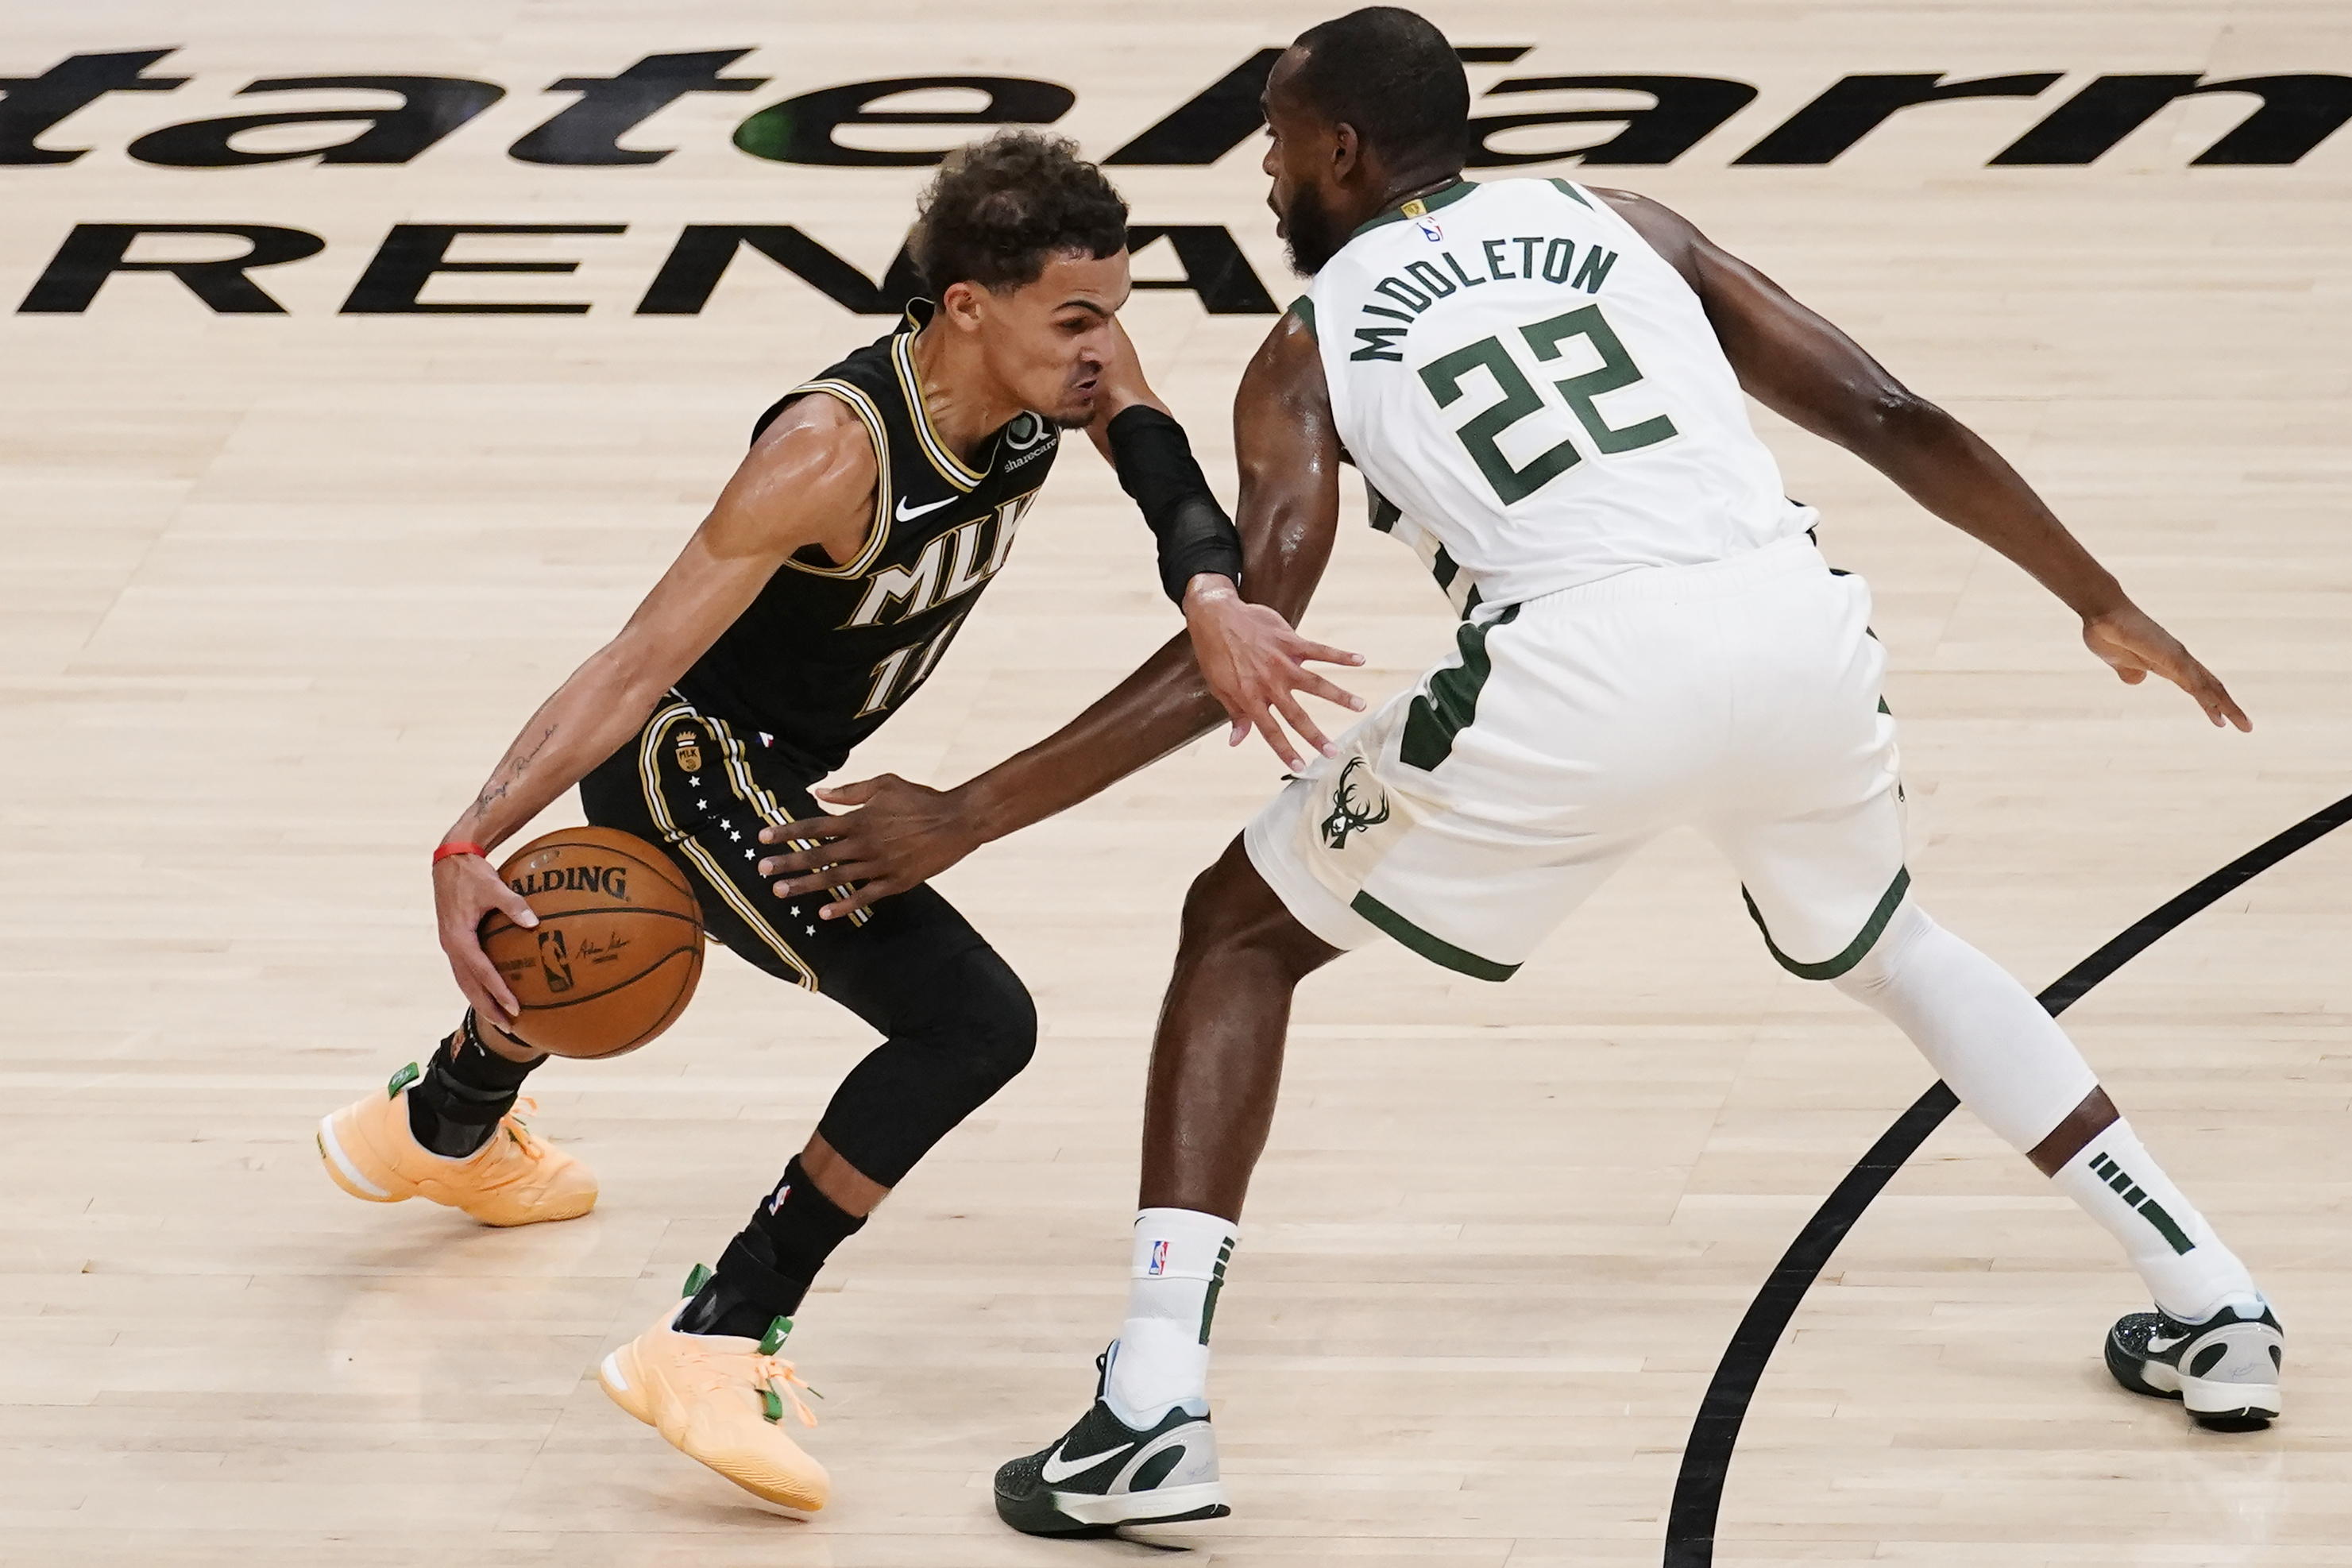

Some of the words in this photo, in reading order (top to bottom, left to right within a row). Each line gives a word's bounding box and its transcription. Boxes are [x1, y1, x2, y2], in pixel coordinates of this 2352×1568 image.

[1350, 236, 1619, 364] MIDDLETON
[1415, 301, 1682, 508] 22
[678, 747, 698, 761] MLK
[511, 865, 628, 901] ALDING
